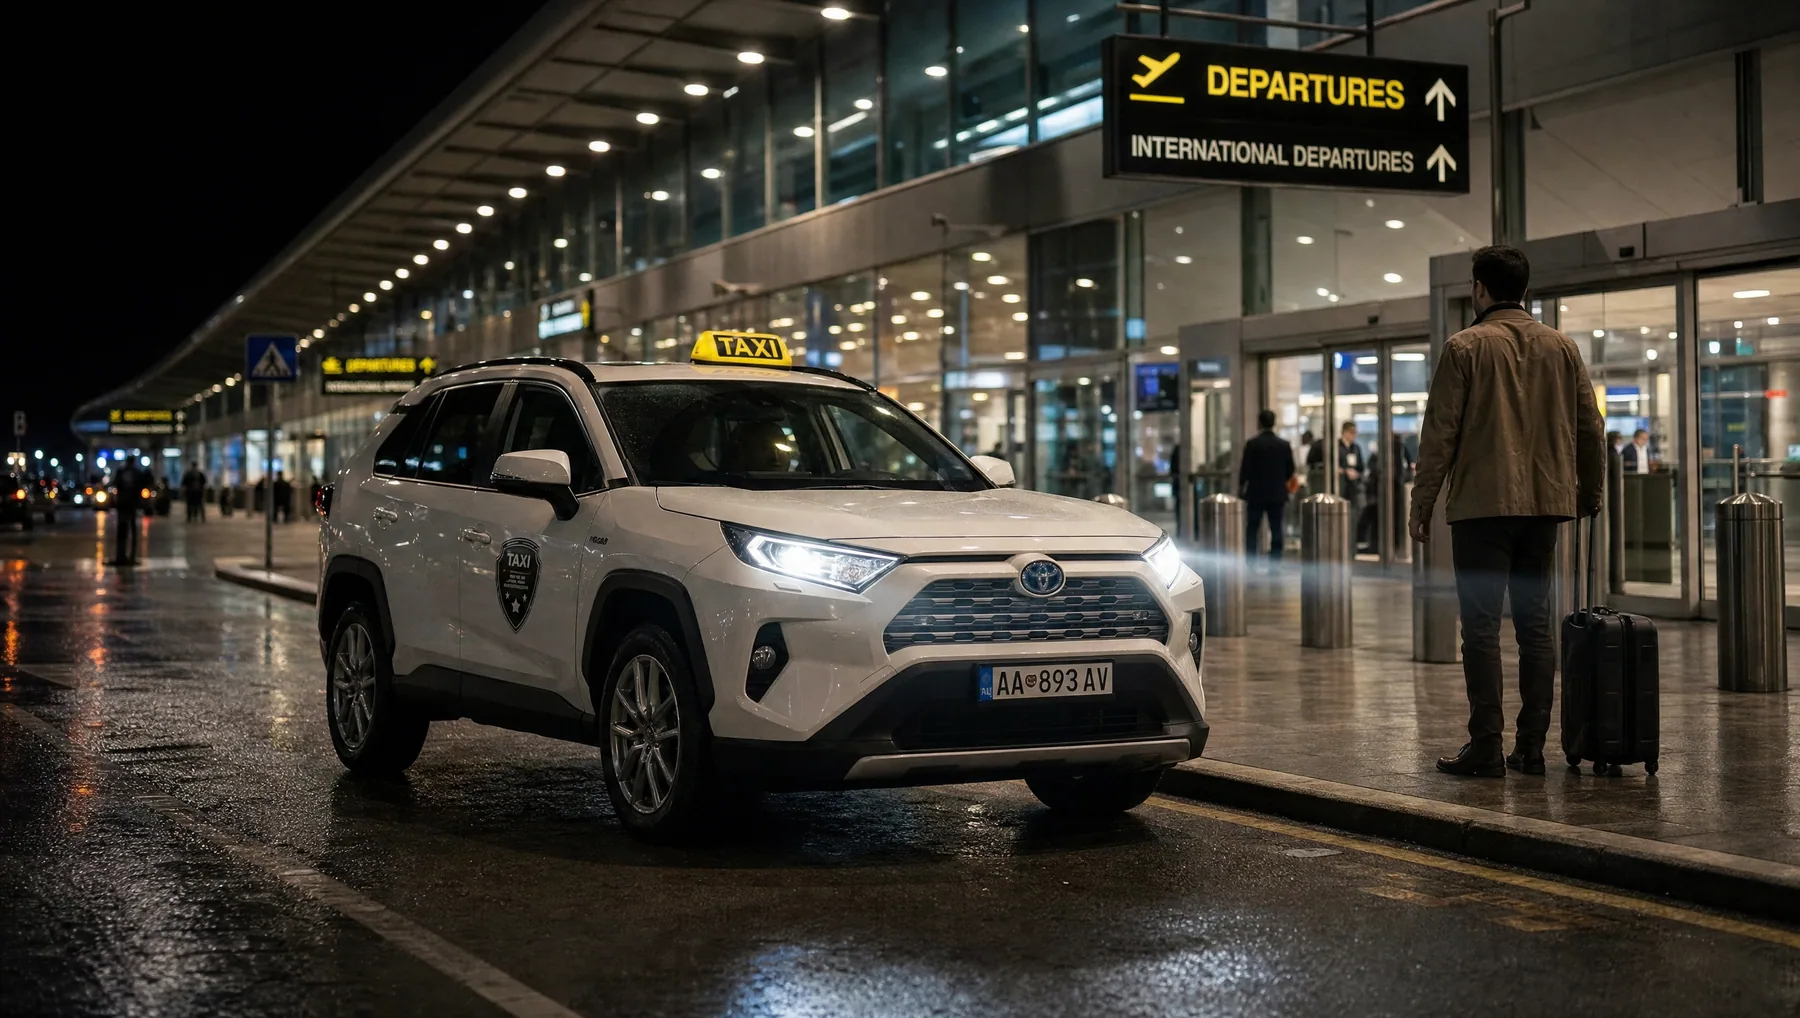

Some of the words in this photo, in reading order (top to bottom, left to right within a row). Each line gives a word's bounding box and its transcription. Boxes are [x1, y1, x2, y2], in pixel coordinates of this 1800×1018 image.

[1207, 64, 1405, 110] DEPARTURES
[1131, 134, 1289, 166] INTERNATIONAL
[1293, 144, 1414, 173] DEPARTURES
[717, 337, 779, 358] TAXI
[507, 552, 531, 569] TAXI
[996, 671, 1025, 696] AA
[1039, 668, 1078, 694] 893
[1083, 667, 1108, 692] AV
